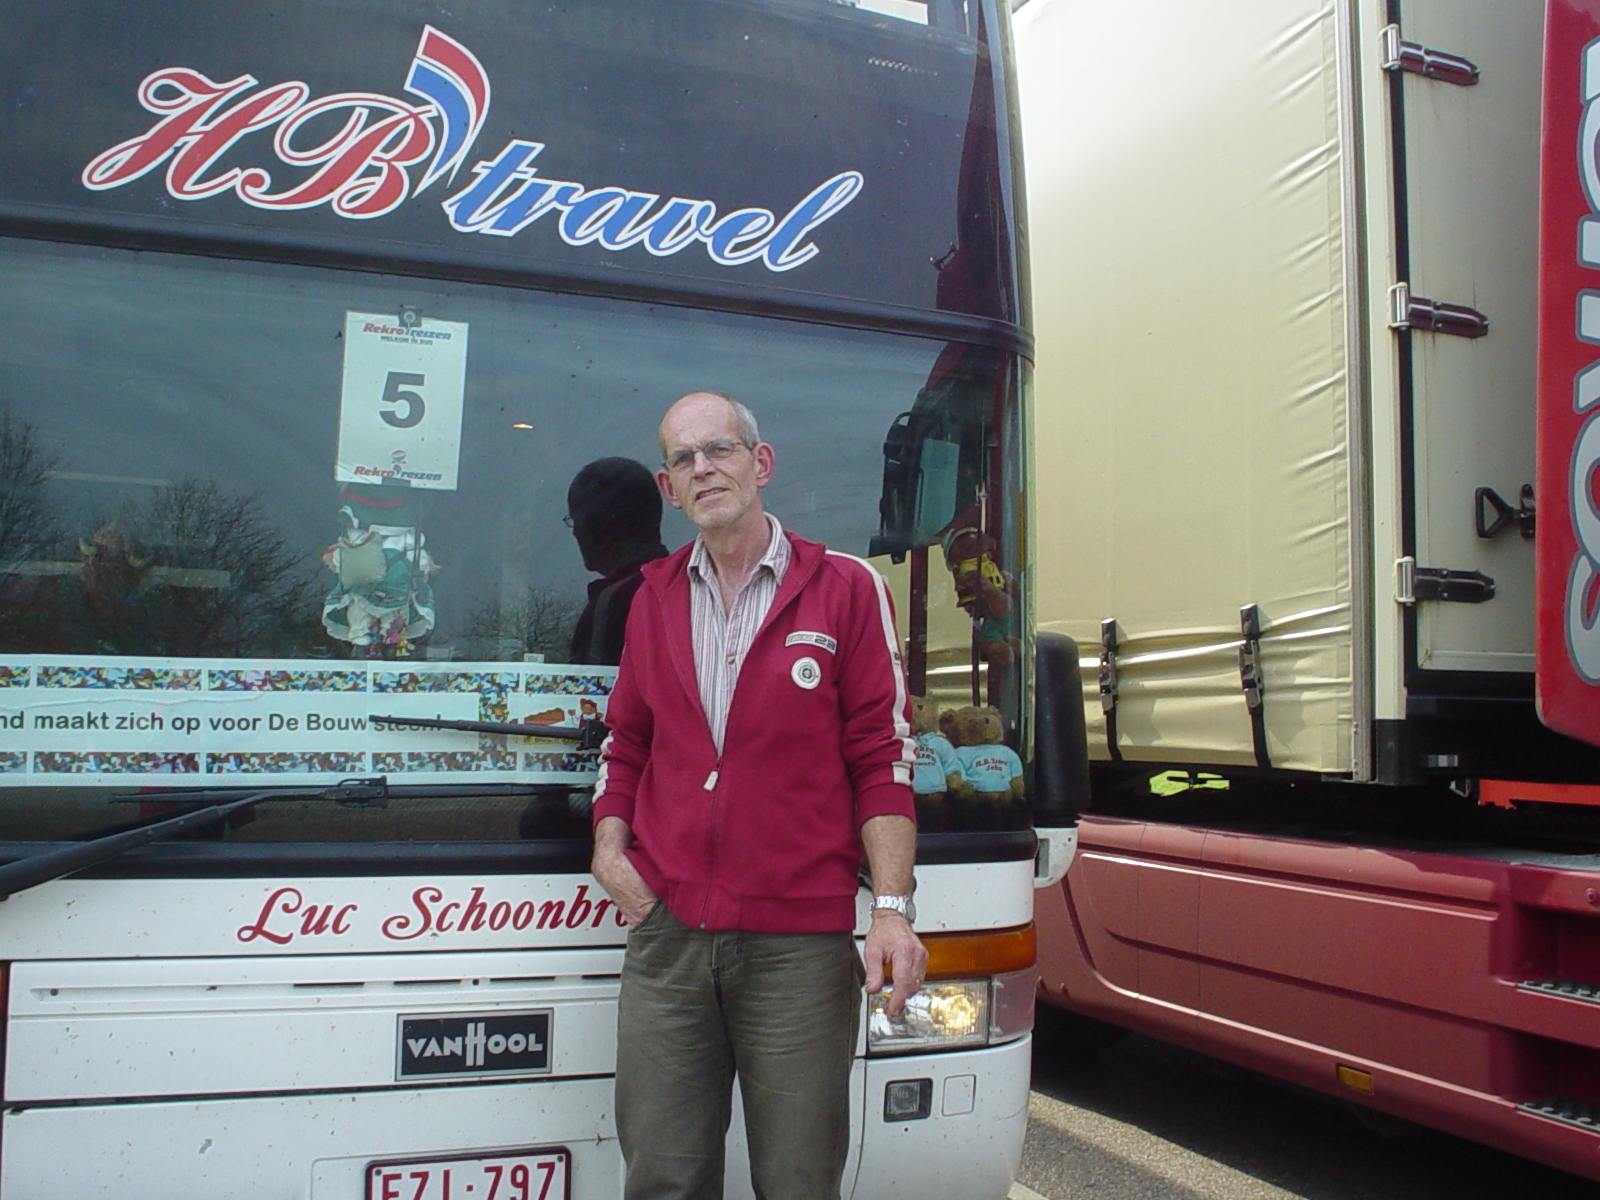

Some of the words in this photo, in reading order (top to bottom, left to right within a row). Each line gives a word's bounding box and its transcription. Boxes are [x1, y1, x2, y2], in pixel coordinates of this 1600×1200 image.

[442, 140, 864, 272] travel
[362, 322, 405, 336] Rekro
[378, 370, 426, 429] 5
[353, 465, 396, 478] Rekro
[400, 470, 443, 481] reizen
[33, 711, 110, 730] maakt
[115, 711, 164, 731] zich
[171, 716, 201, 735] op
[208, 717, 262, 732] voor
[268, 713, 299, 732] De
[236, 887, 358, 945] Luc
